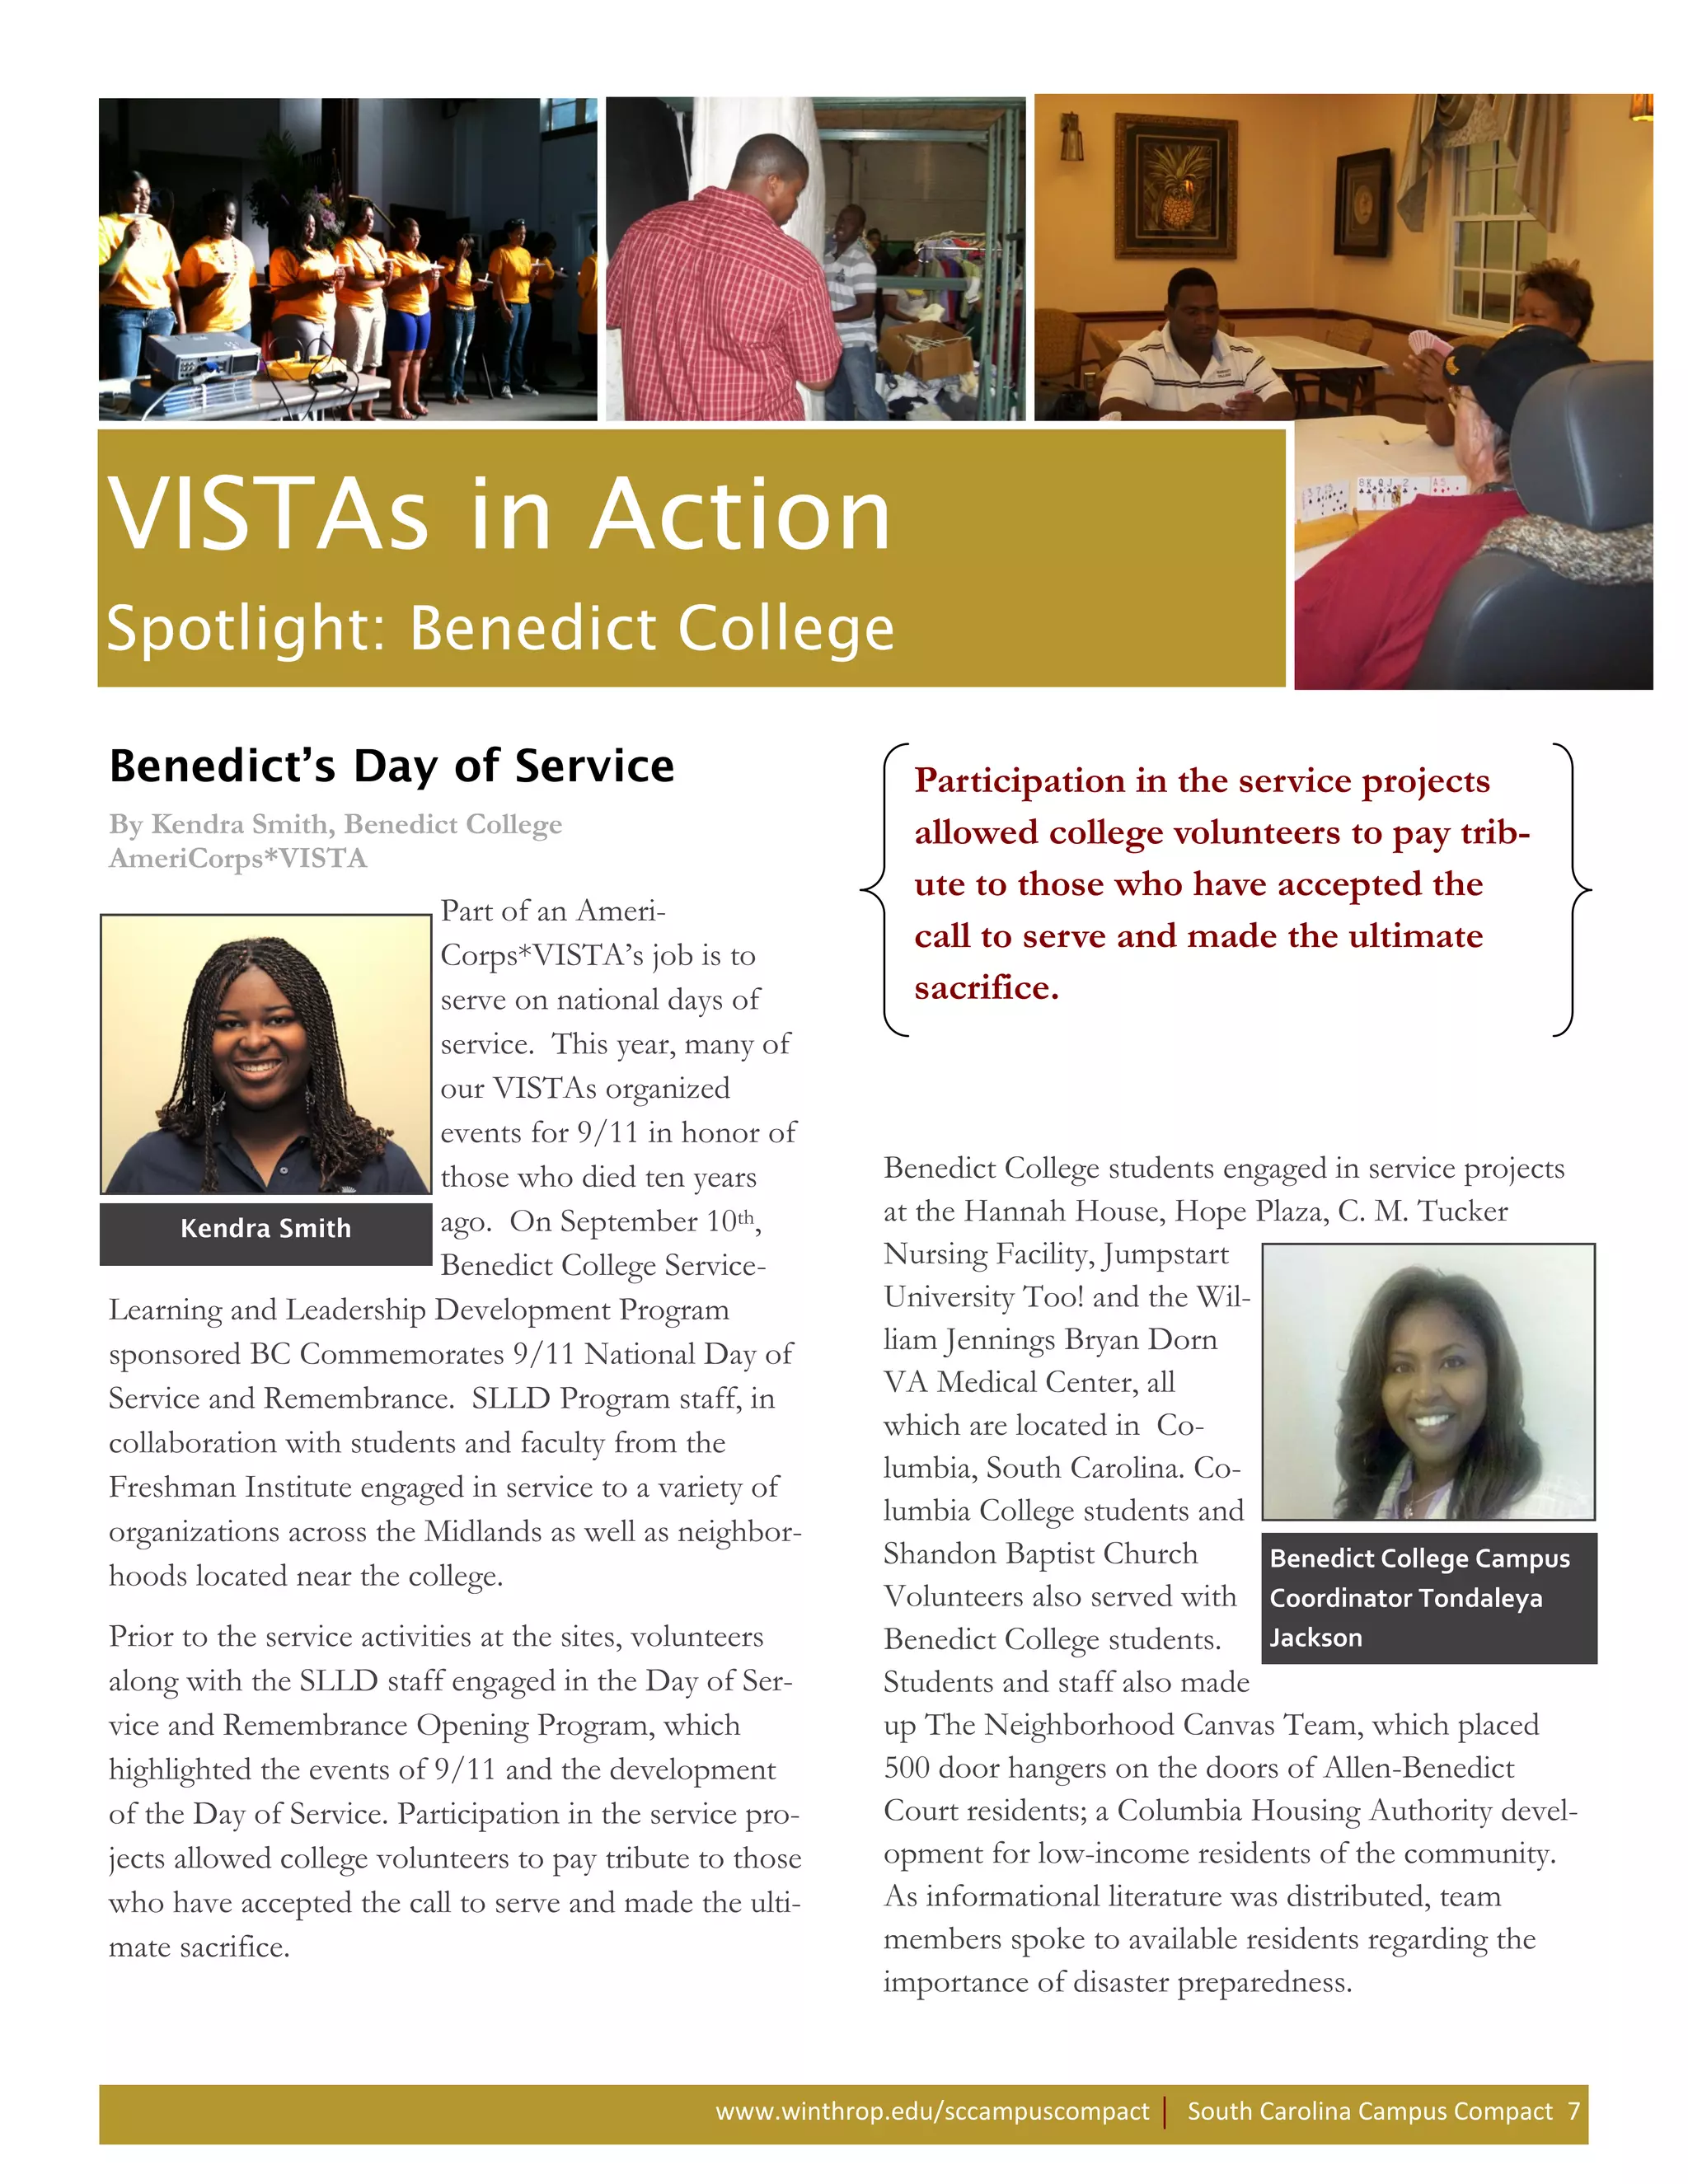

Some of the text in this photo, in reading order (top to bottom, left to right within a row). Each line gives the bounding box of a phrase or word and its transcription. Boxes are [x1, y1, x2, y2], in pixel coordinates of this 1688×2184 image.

[106, 474, 888, 551] VISTAs in Action
[107, 602, 893, 663] Spotlight: Benedict College
[355, 748, 439, 791] Day
[455, 745, 502, 783] of
[516, 747, 674, 783] Service
[914, 766, 1491, 803] Participation in the service projects
[109, 813, 563, 841] By Kendra Smith, Benedict College
[915, 818, 1531, 855] allowed college volunteers to pay trib-
[914, 869, 1484, 906] ute to those who have accepted the
[440, 898, 666, 922] Part of an Ameri-
[914, 921, 1484, 949] call to serve and made the ultimate
[915, 972, 1059, 1001] sacrifice.
[441, 1031, 793, 1062] service. This year, many of
[440, 1118, 799, 1147] events for 9/11 in honor of
[181, 1216, 351, 1239] Kendra Smith
[440, 1208, 762, 1240] ago. On September 10th,
[884, 1198, 1509, 1230] at the Hannah House, Hope Plaza, C. M. Tucker
[108, 1296, 730, 1329] Learning and Leadership Development Program
[110, 1339, 795, 1373] sponsored BC Commemorates 9/11 National Day of
[883, 1369, 1176, 1399] VA Medical Center, all
[109, 1430, 726, 1461] collaboration with students and faculty from the
[883, 1455, 1241, 1484] lumbia, South Carolina. Co-
[884, 1540, 1199, 1572] Shandon Baptist Church
[1271, 1547, 1571, 1575] Benedict College Campus
[109, 1563, 503, 1595] hoods located near the college.
[1270, 1586, 1543, 1614] Coordinator Tondaleya
[1269, 1626, 1362, 1647] Jackson
[108, 1712, 741, 1744] vice and Remembrance Opening Program, which
[884, 1797, 1578, 1830] Court residents; a Columbia Housing Authority devel-
[883, 1883, 1502, 1913] As informational literature was distributed, team
[108, 1933, 289, 1958] mate sacrifice.
[883, 1969, 1352, 2001] importance of disaster preparedness.
[715, 2099, 1151, 2125] www.winthrop.edu/sccampuscompact
[1188, 2100, 1581, 2125] South Carolina Campus Compact 7
